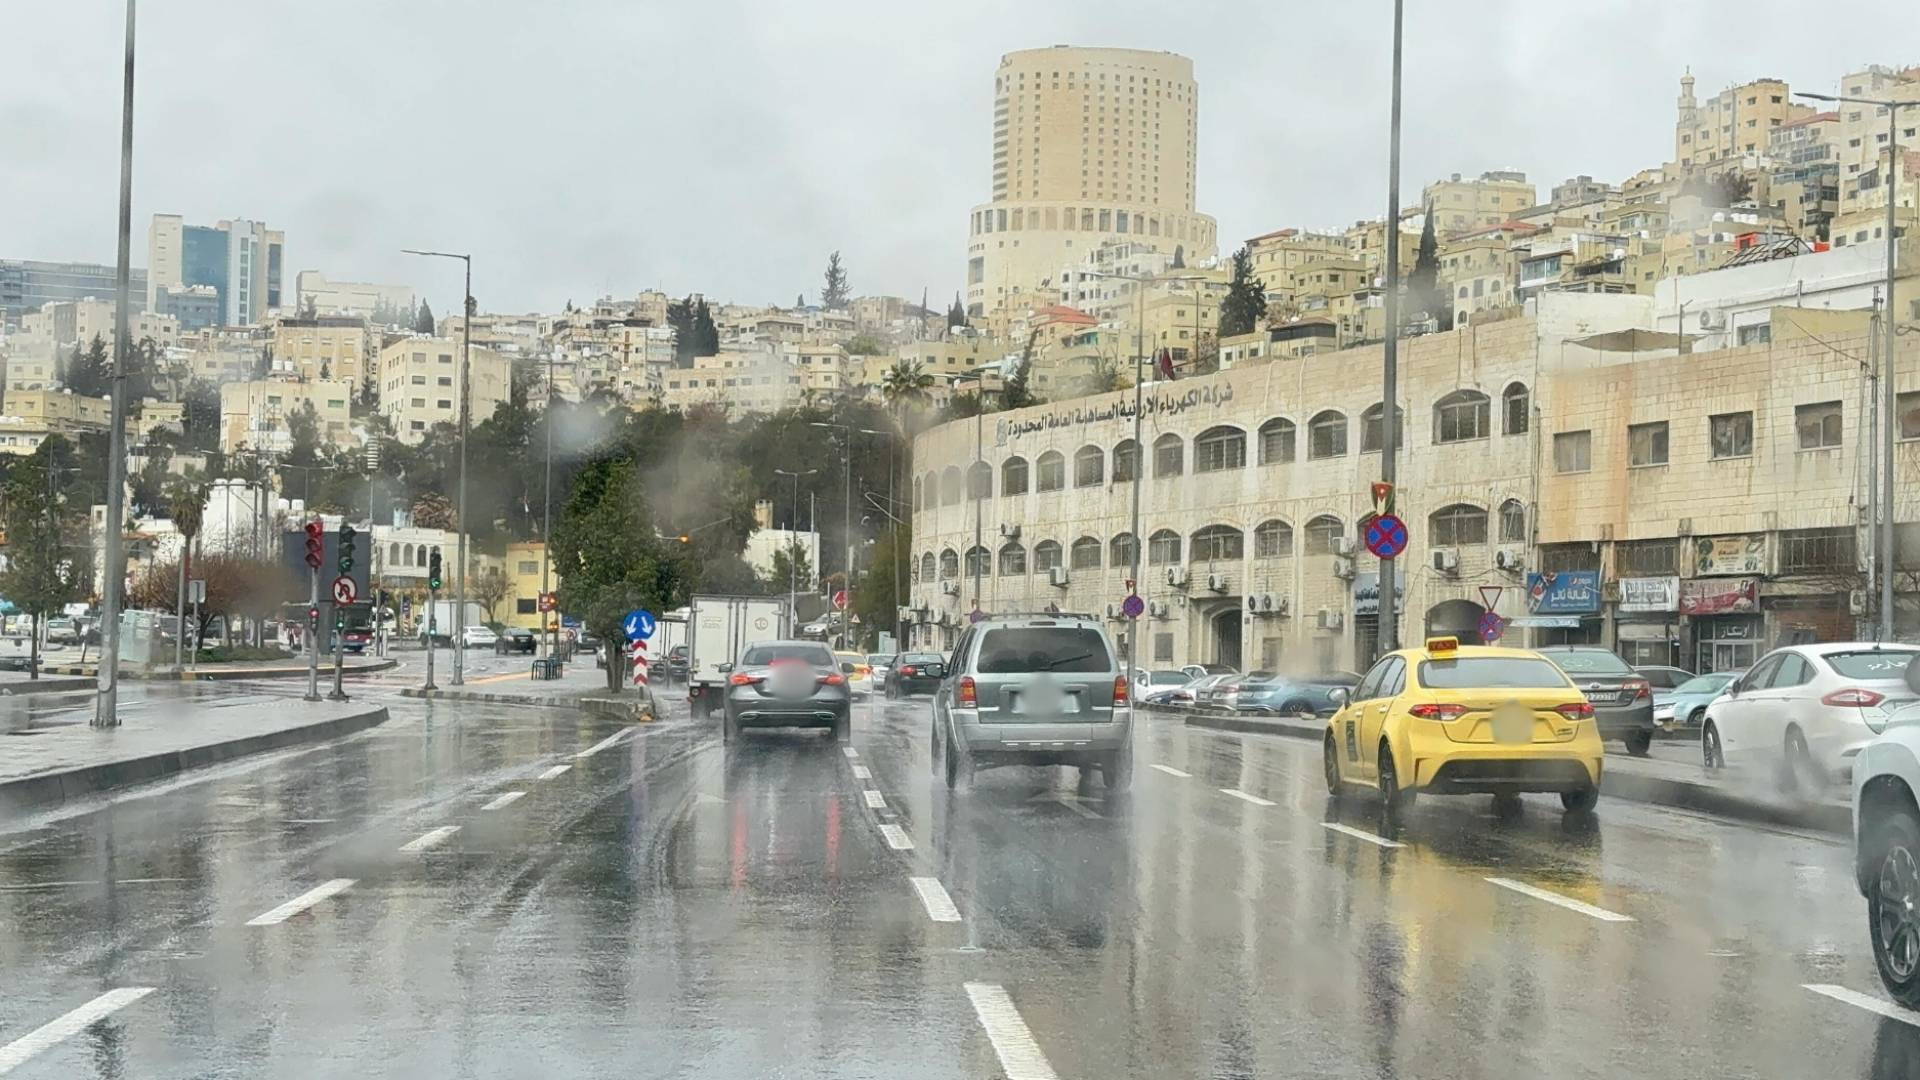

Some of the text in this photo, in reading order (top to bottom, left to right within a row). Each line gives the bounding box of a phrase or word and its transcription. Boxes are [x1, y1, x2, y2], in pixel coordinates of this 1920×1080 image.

[1159, 387, 1201, 416] الكهرباء
[1202, 381, 1234, 407] شركة
[1048, 411, 1074, 429] العامة
[1119, 393, 1158, 422] الارنية
[1008, 413, 1048, 439] المحدودة
